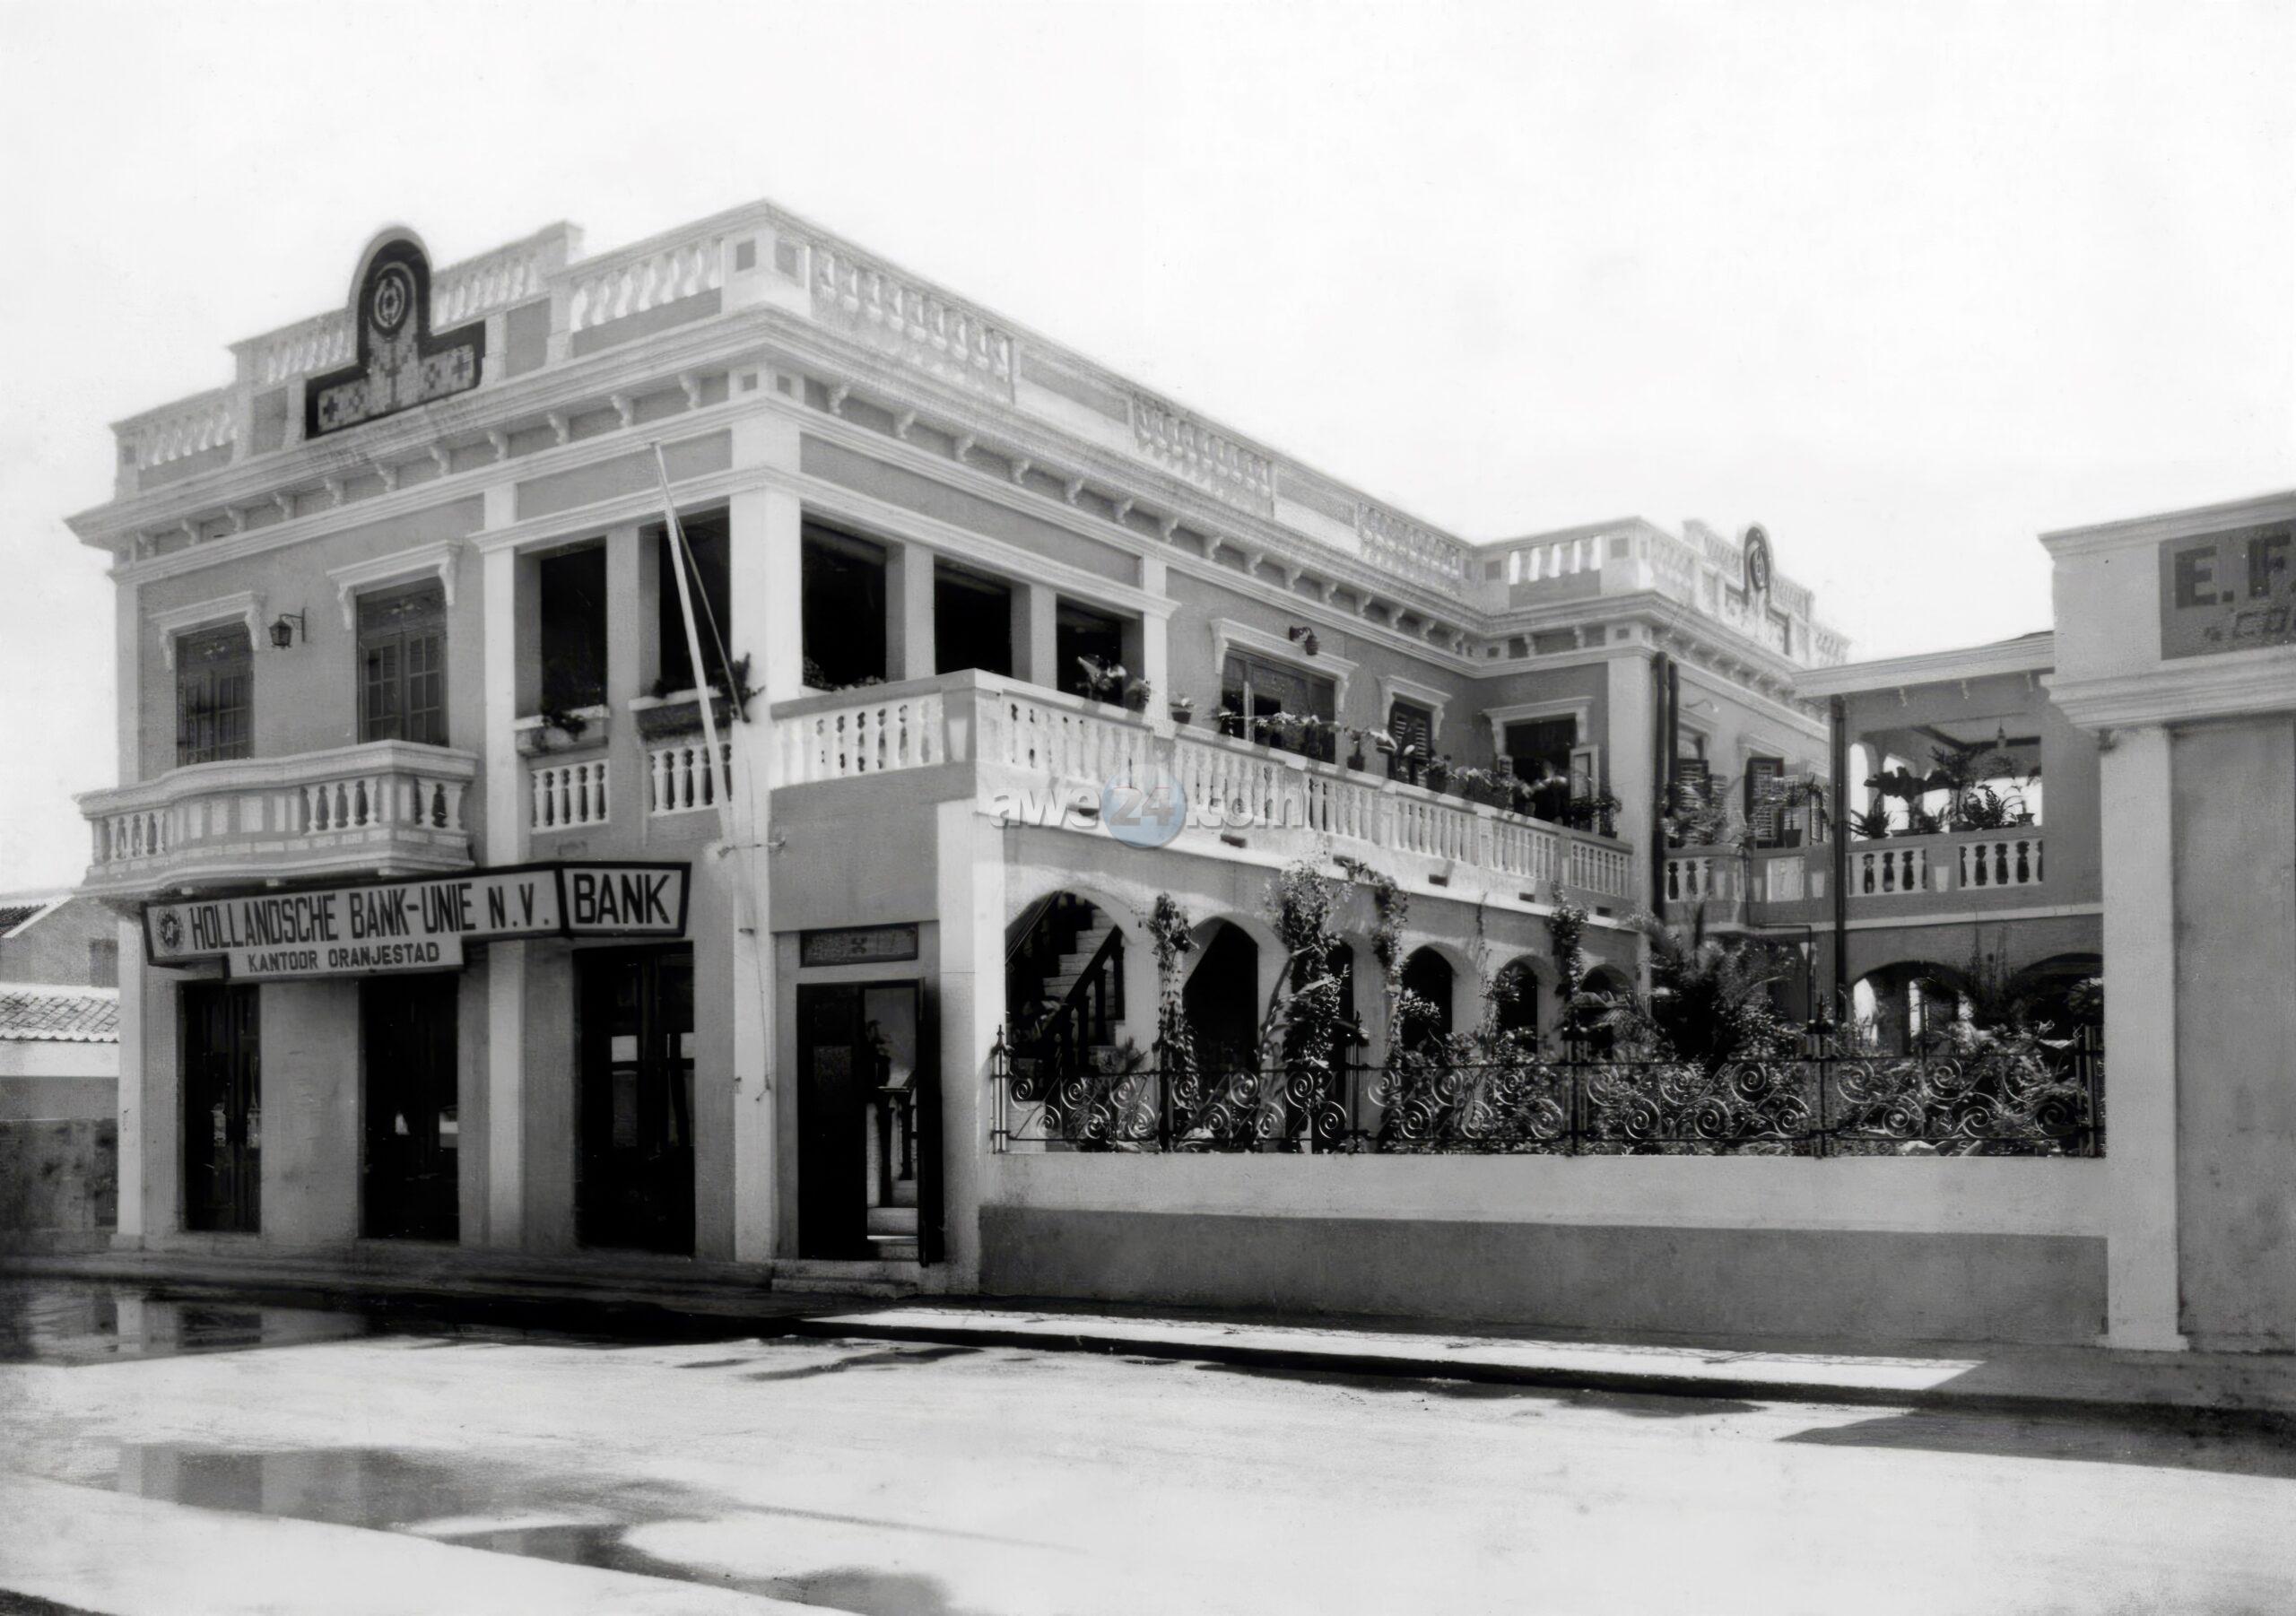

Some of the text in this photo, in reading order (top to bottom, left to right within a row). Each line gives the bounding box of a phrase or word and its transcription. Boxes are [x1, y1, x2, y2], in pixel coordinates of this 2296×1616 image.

[189, 882, 550, 950] HOLLANDSCHE BANK-UNIE N.V.
[573, 873, 671, 925] BANK
[248, 943, 439, 972] KANTOOR ORANJESTAD
